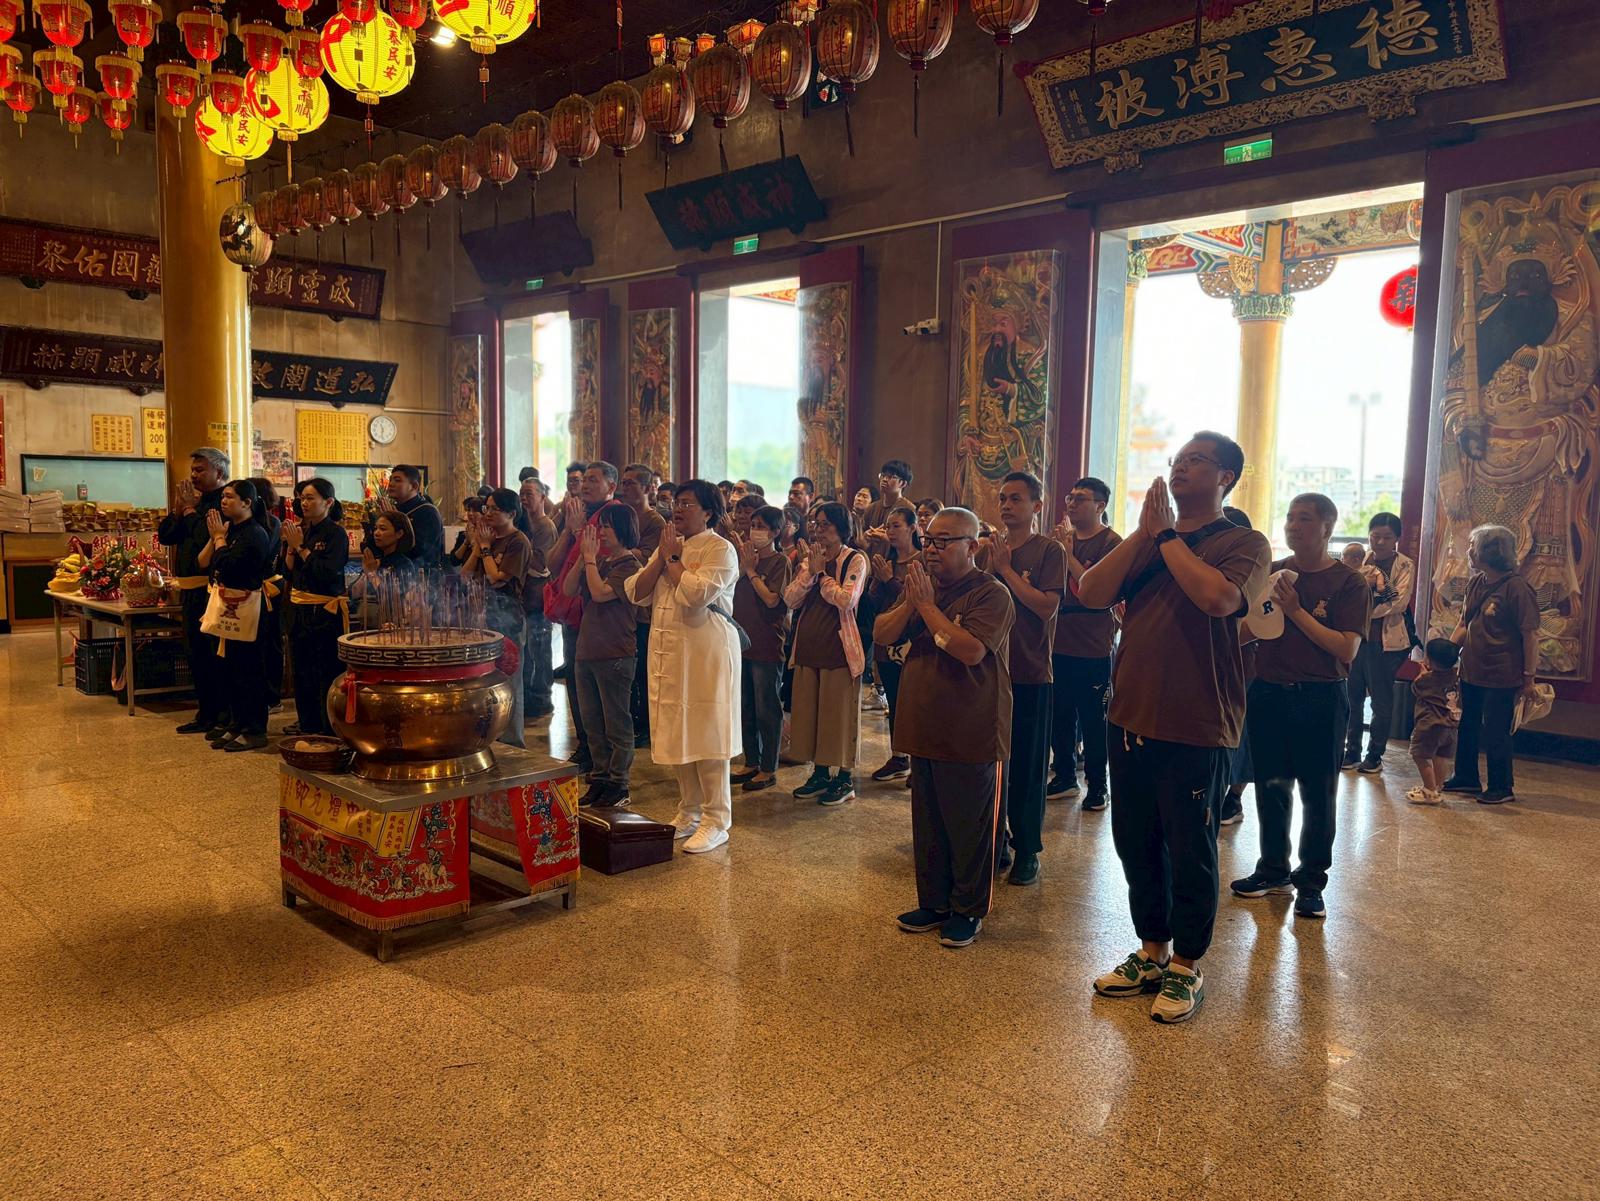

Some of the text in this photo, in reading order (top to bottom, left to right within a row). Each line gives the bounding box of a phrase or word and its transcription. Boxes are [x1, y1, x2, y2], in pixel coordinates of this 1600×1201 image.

[383, 16, 402, 81] 國泰民安
[235, 104, 250, 147] 泰民安
[251, 265, 356, 310] 威靈顯
[149, 433, 164, 443] 200
[1262, 600, 1274, 615] R
